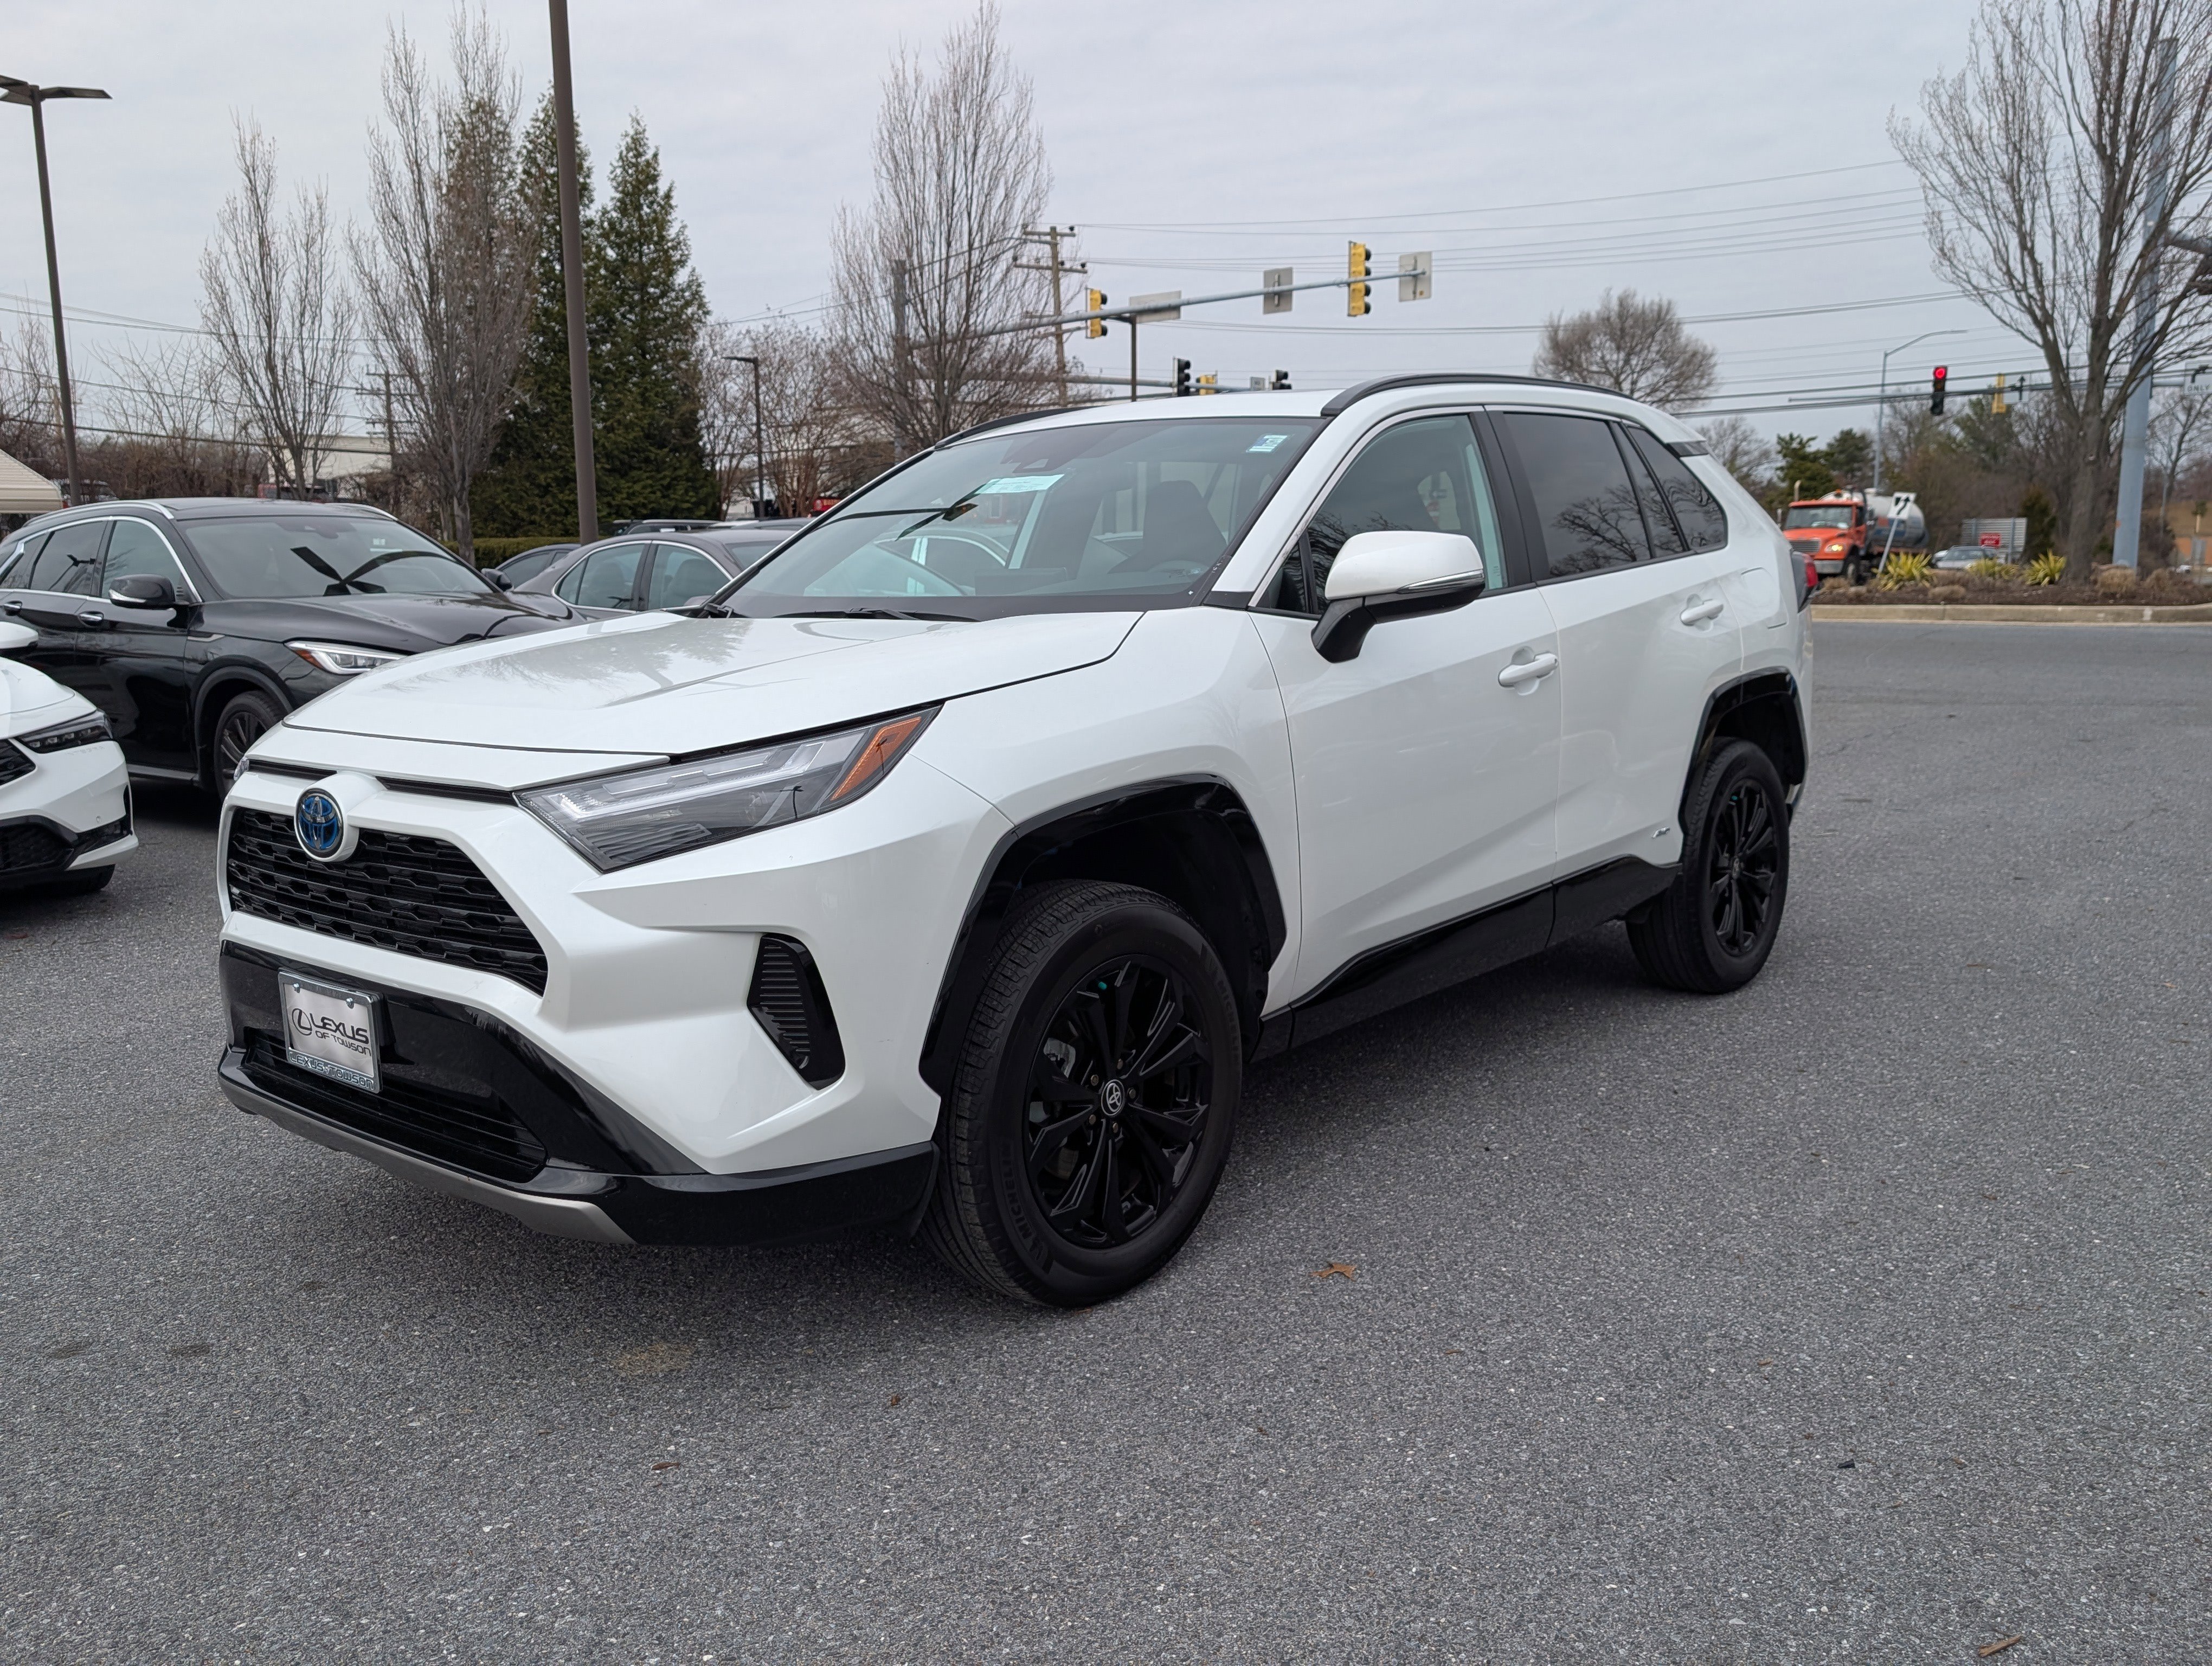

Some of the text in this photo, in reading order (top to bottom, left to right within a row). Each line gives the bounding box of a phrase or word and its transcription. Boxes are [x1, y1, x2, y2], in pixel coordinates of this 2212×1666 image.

[2187, 384, 2210, 392] ONLY
[310, 1013, 369, 1045] LEXUS
[315, 1030, 372, 1056] OF TOWSON
[290, 1052, 374, 1090] LEXUS TOWSON
